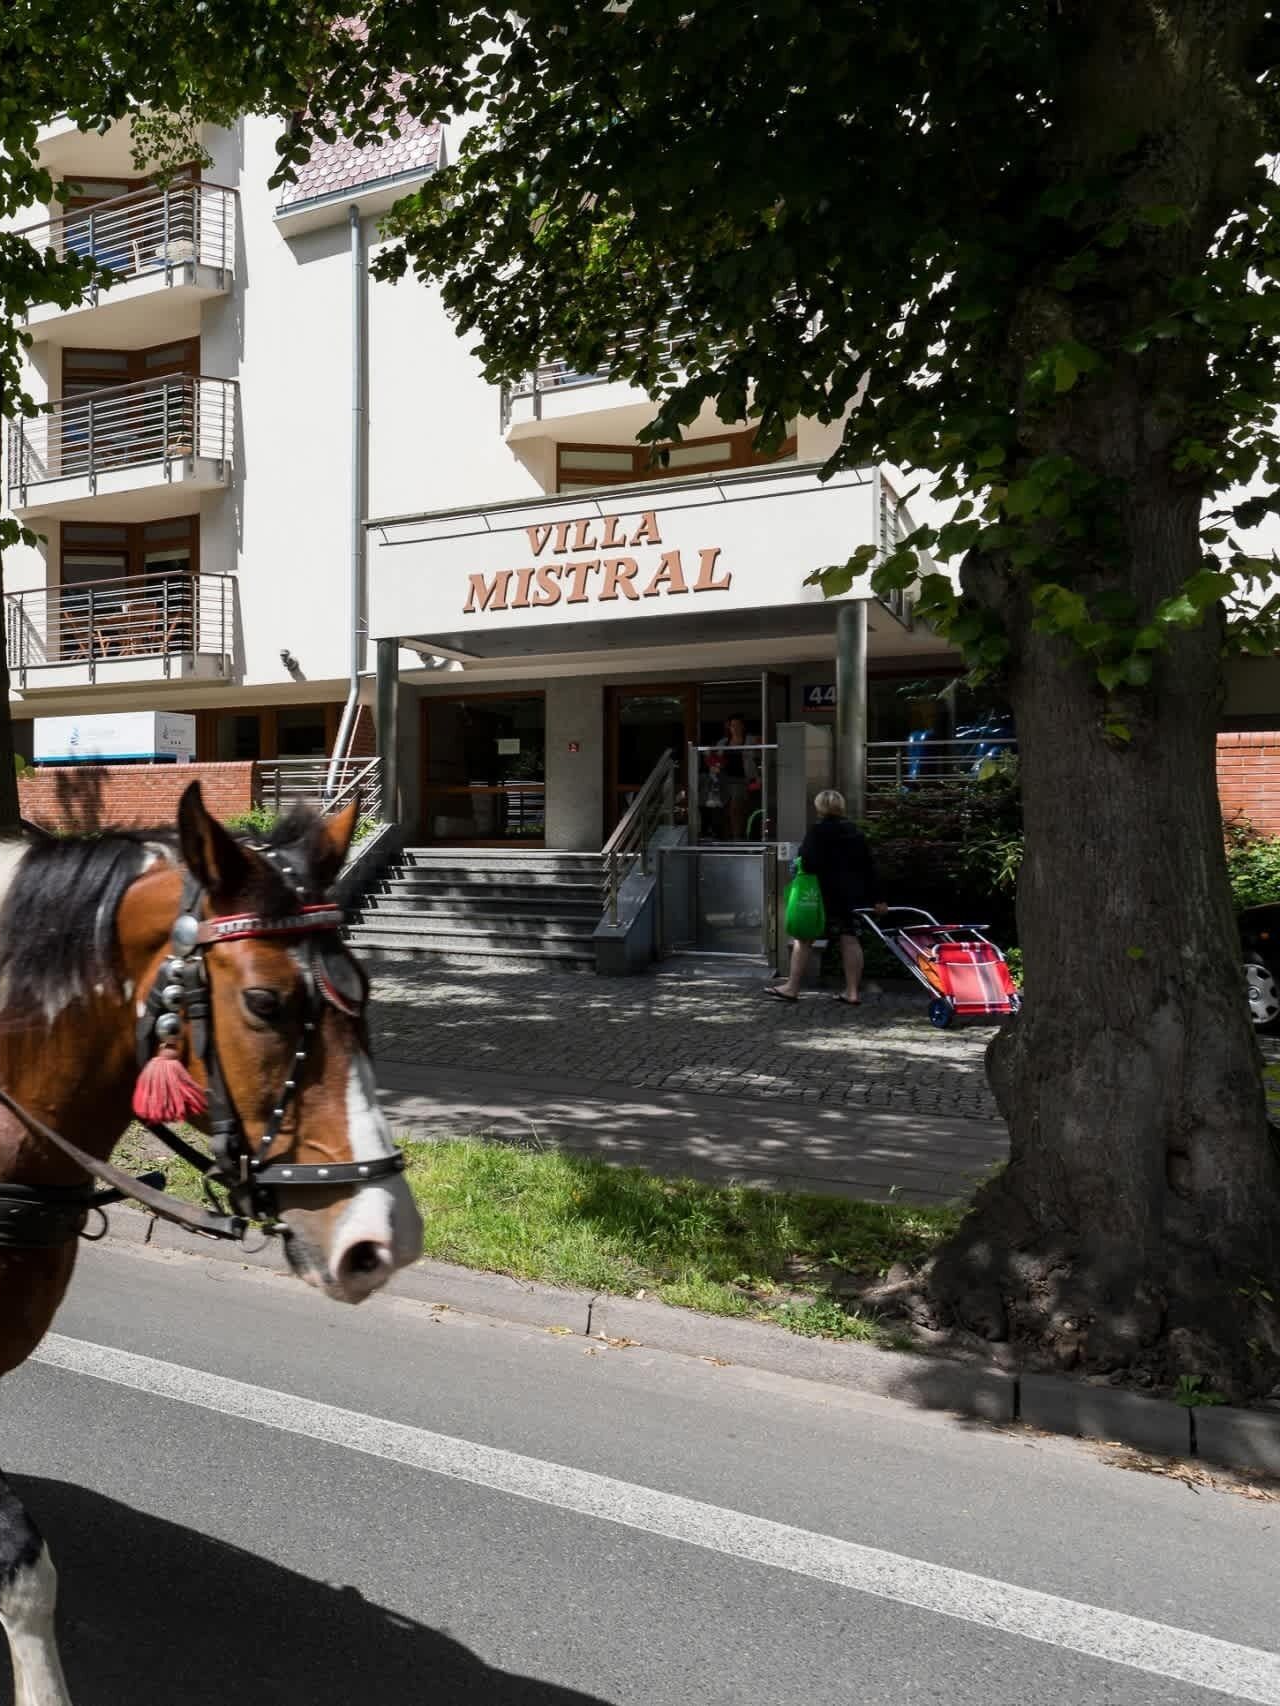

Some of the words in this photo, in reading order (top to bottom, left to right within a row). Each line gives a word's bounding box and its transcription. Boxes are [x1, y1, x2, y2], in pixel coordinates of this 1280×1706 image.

[526, 511, 662, 556] VILLA
[463, 548, 731, 613] MISTRAL
[809, 686, 836, 704] 44
